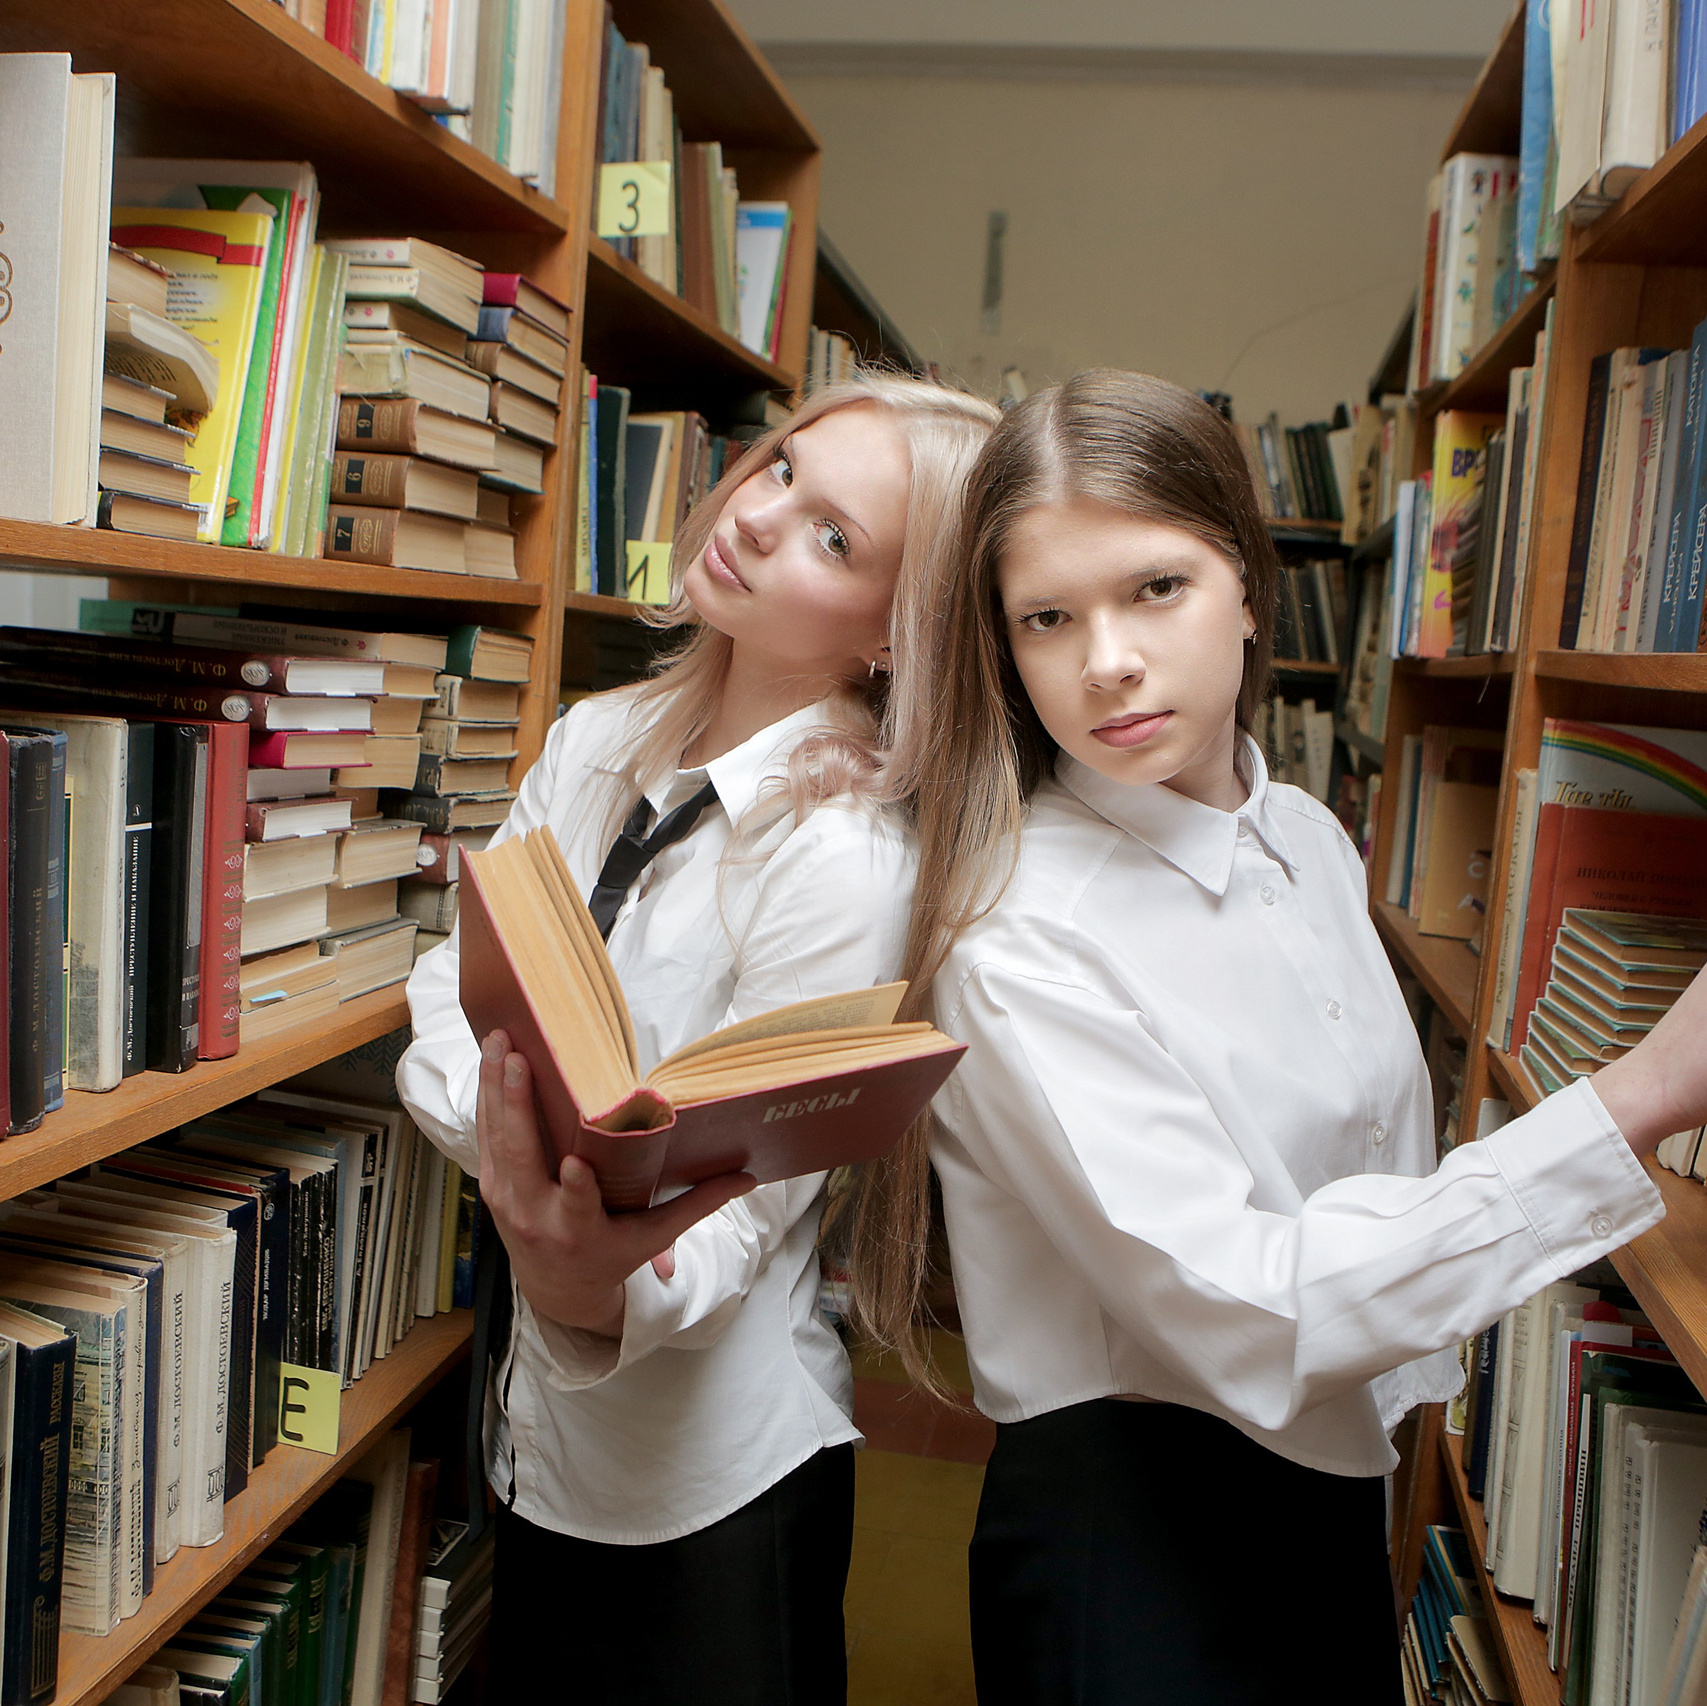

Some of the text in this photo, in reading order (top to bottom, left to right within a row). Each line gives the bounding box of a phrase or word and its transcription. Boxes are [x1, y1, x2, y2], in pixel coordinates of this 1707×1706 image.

[1663, 511, 1681, 604] КРЕЙСЕРА
[1688, 503, 1707, 601] КРЕЙСЕРА
[1505, 810, 1522, 913] РАССКАЗЫ
[129, 902, 137, 977] ПРЕСТУПЛЕНИЕ
[763, 1088, 861, 1124] БЕСЫ
[48, 1360, 65, 1425] РАССКАЗЫ
[1567, 1448, 1587, 1609] МИХАИЛ ПРИШВИН
